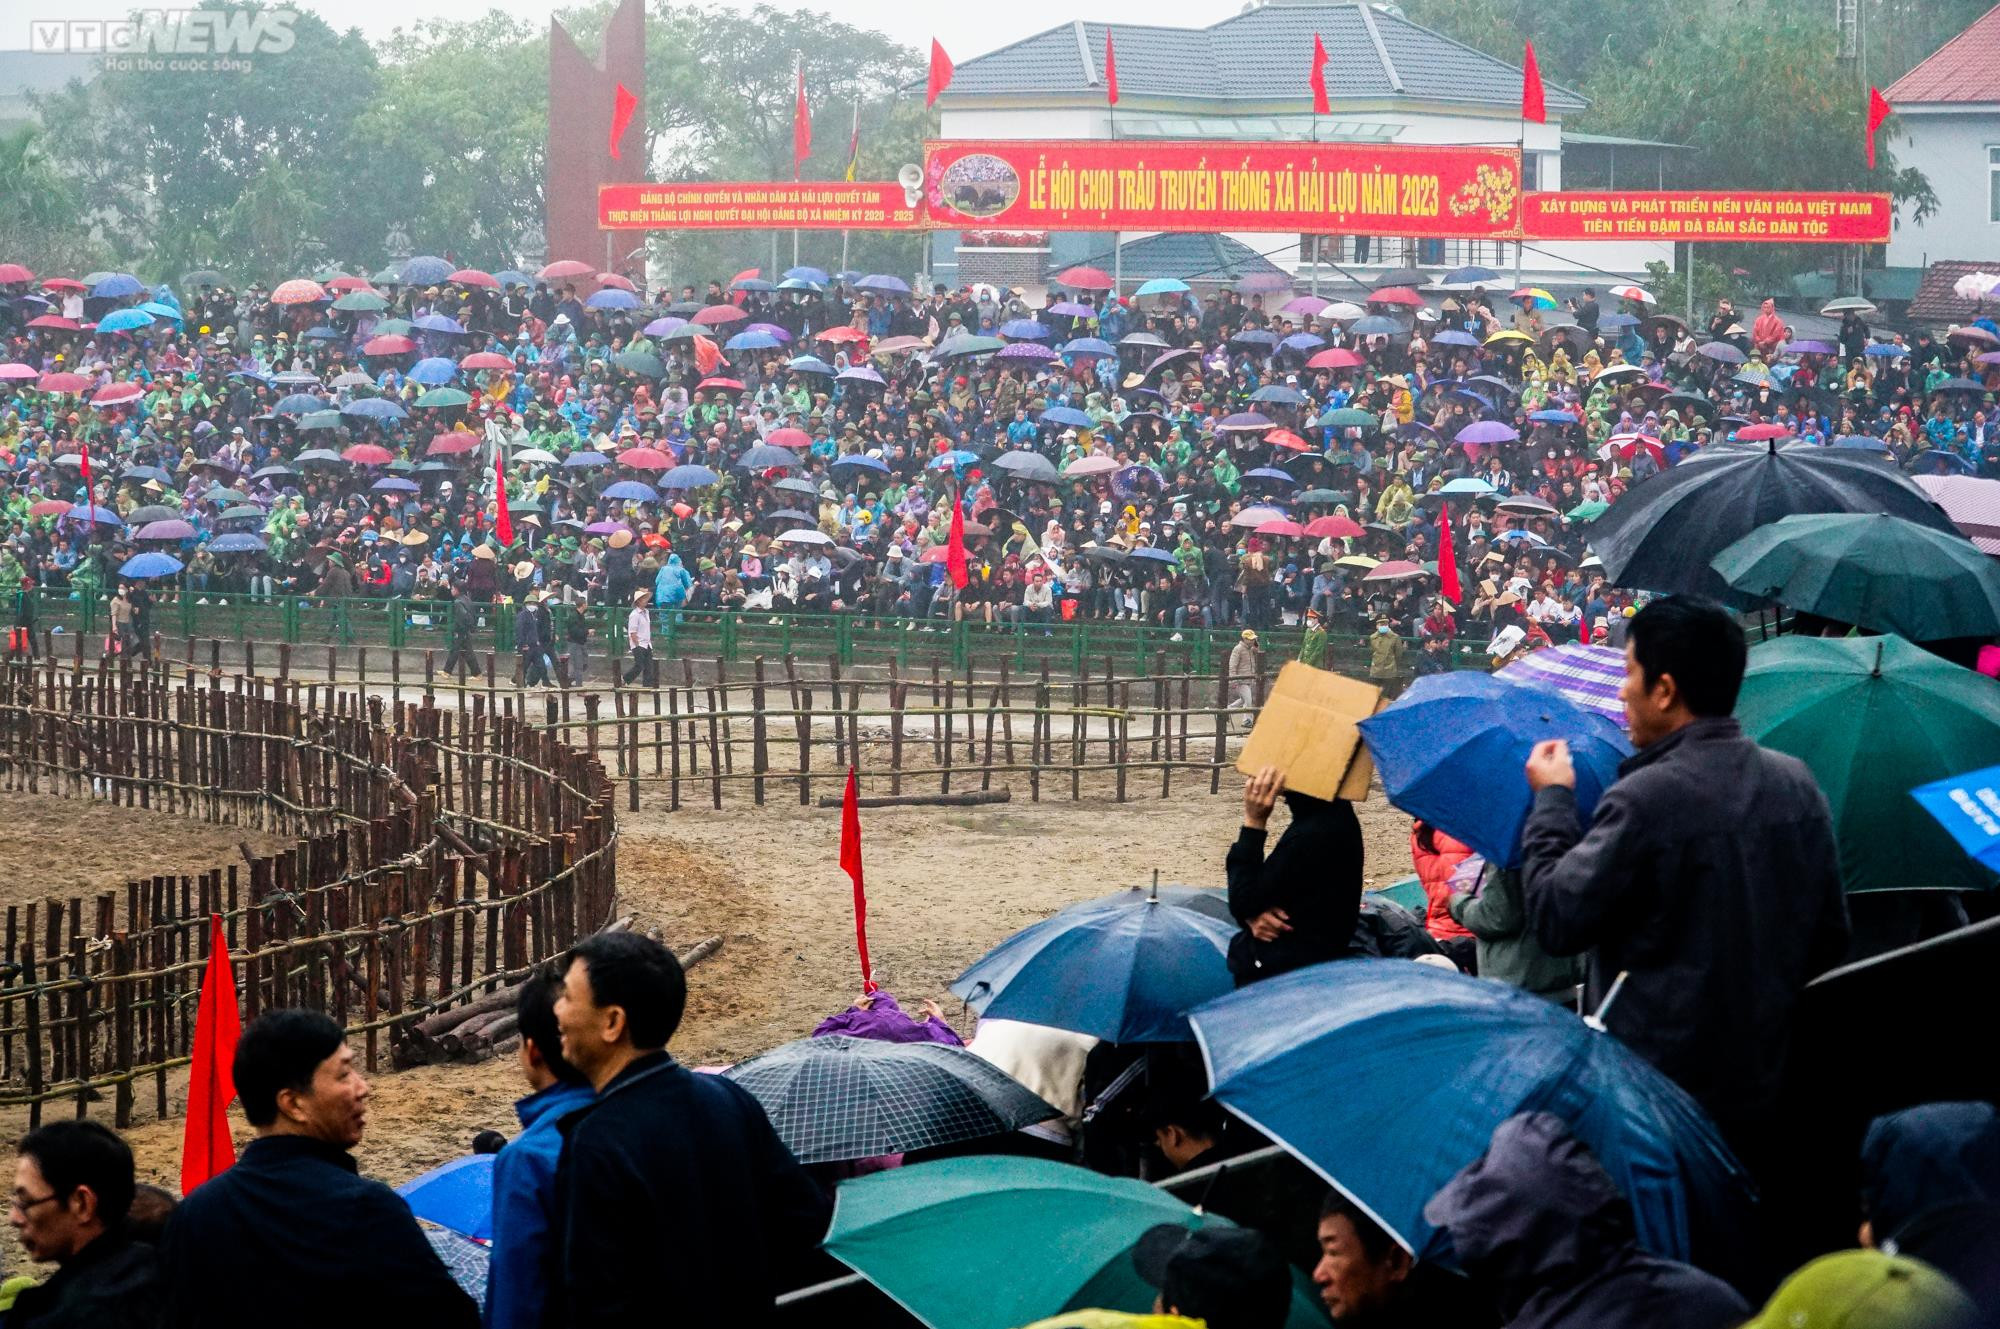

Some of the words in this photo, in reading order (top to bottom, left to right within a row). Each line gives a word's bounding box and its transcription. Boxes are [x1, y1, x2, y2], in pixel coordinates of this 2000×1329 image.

[664, 191, 675, 206] BỘ
[677, 191, 702, 204] CHÍNH
[732, 190, 743, 204] VÀ
[744, 190, 767, 204] NHÂN
[769, 190, 787, 204] DÂN
[788, 190, 799, 203] XÃ
[802, 189, 816, 203] HẢI
[835, 188, 860, 205] QUYẾT
[862, 190, 880, 204] TÂM
[1029, 154, 1046, 210] LỄ
[1050, 160, 1075, 219] HỘI
[1079, 168, 1113, 219] CHỌI
[1118, 160, 1155, 210] TRÂU
[1221, 155, 1270, 211] THỐNG
[1274, 163, 1295, 212] XÃ
[1299, 157, 1324, 212] HẢI
[1328, 168, 1357, 222] LỰU
[1361, 164, 1397, 216] NĂM
[1401, 174, 1439, 217] 2023
[630, 208, 649, 224] HIỆN
[693, 210, 713, 223] NGHỊ
[714, 206, 739, 222] QUYẾT
[757, 208, 770, 223] HỘI
[797, 208, 809, 222] BỘ
[810, 207, 822, 221] XÃ
[823, 208, 850, 223] NHIỆM
[864, 210, 885, 221] 2020
[893, 210, 914, 222] 2025
[1540, 198, 1567, 213] XÂY
[1570, 200, 1607, 216] DỰNG
[1610, 198, 1628, 213] VÀ
[1632, 198, 1667, 213] PHÁT
[1669, 196, 1709, 213] TRIỂN
[1744, 199, 1772, 214] VĂN
[1775, 199, 1803, 214] HÓA
[1807, 200, 1836, 217] VIỆT
[1839, 202, 1872, 215] NAM
[1583, 217, 1612, 233] TIÊN
[1616, 216, 1646, 233] TIẾN
[1649, 217, 1680, 235] ĐẬM
[1684, 218, 1703, 233] ĐÀ
[1706, 217, 1735, 233] BẢN
[1738, 216, 1766, 233] SẮC
[1769, 219, 1798, 234] DÂN
[1801, 219, 1829, 236] TỘC
